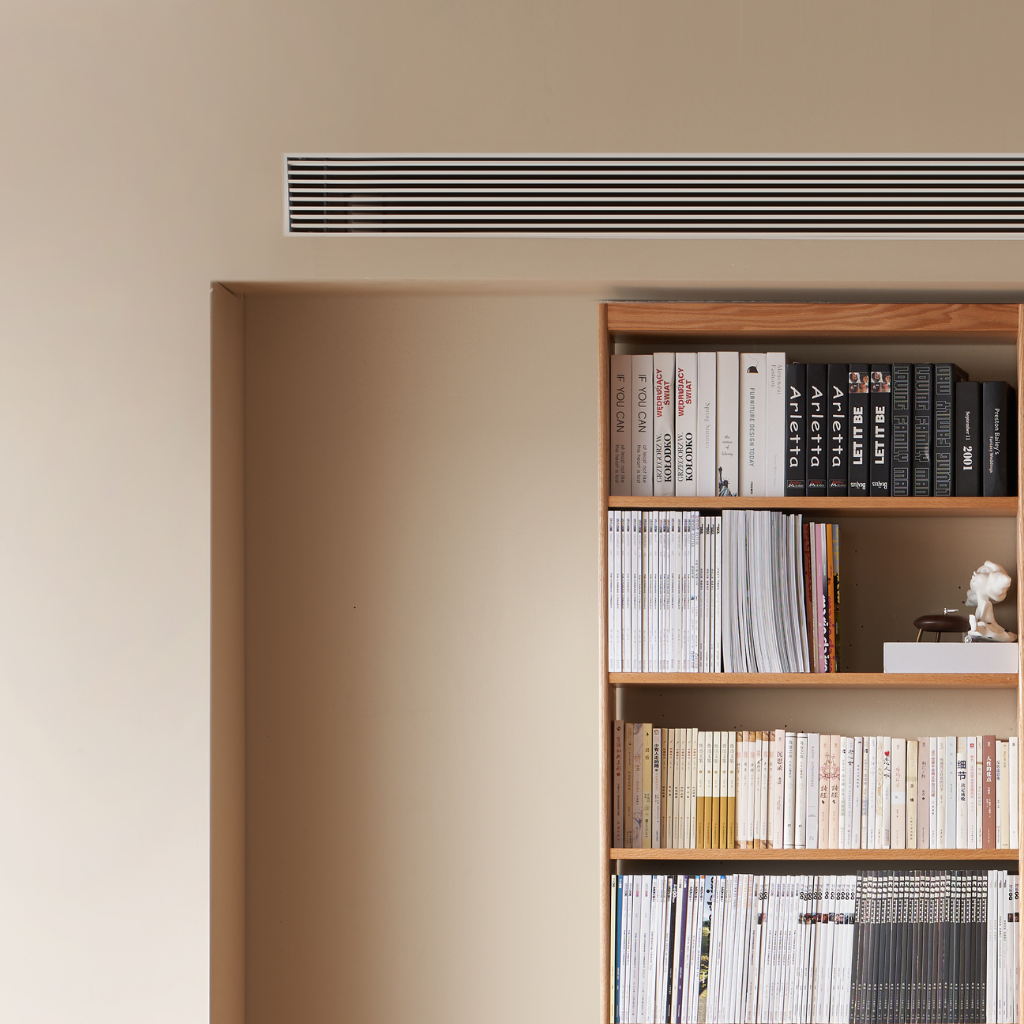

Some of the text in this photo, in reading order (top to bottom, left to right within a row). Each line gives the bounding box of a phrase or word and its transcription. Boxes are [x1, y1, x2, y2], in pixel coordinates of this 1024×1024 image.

[616, 374, 625, 433] IF YOU CAN
[638, 387, 647, 408] YOU
[638, 411, 647, 433] CAN
[789, 386, 802, 467] Arletta
[811, 386, 824, 467] Arletta
[832, 386, 845, 467] Arletta
[663, 433, 672, 482] KOŁODKO
[685, 432, 693, 481] KOŁODKO
[852, 406, 863, 465] LET IT BE
[874, 406, 885, 465] LET IT BE
[894, 367, 909, 496] LOVING FAMILY MAN
[915, 367, 930, 496] LOVING FAMILY MAN
[936, 366, 951, 496] LOVING FAMILY MAN
[963, 446, 972, 470] 2001
[957, 760, 966, 780] 细节
